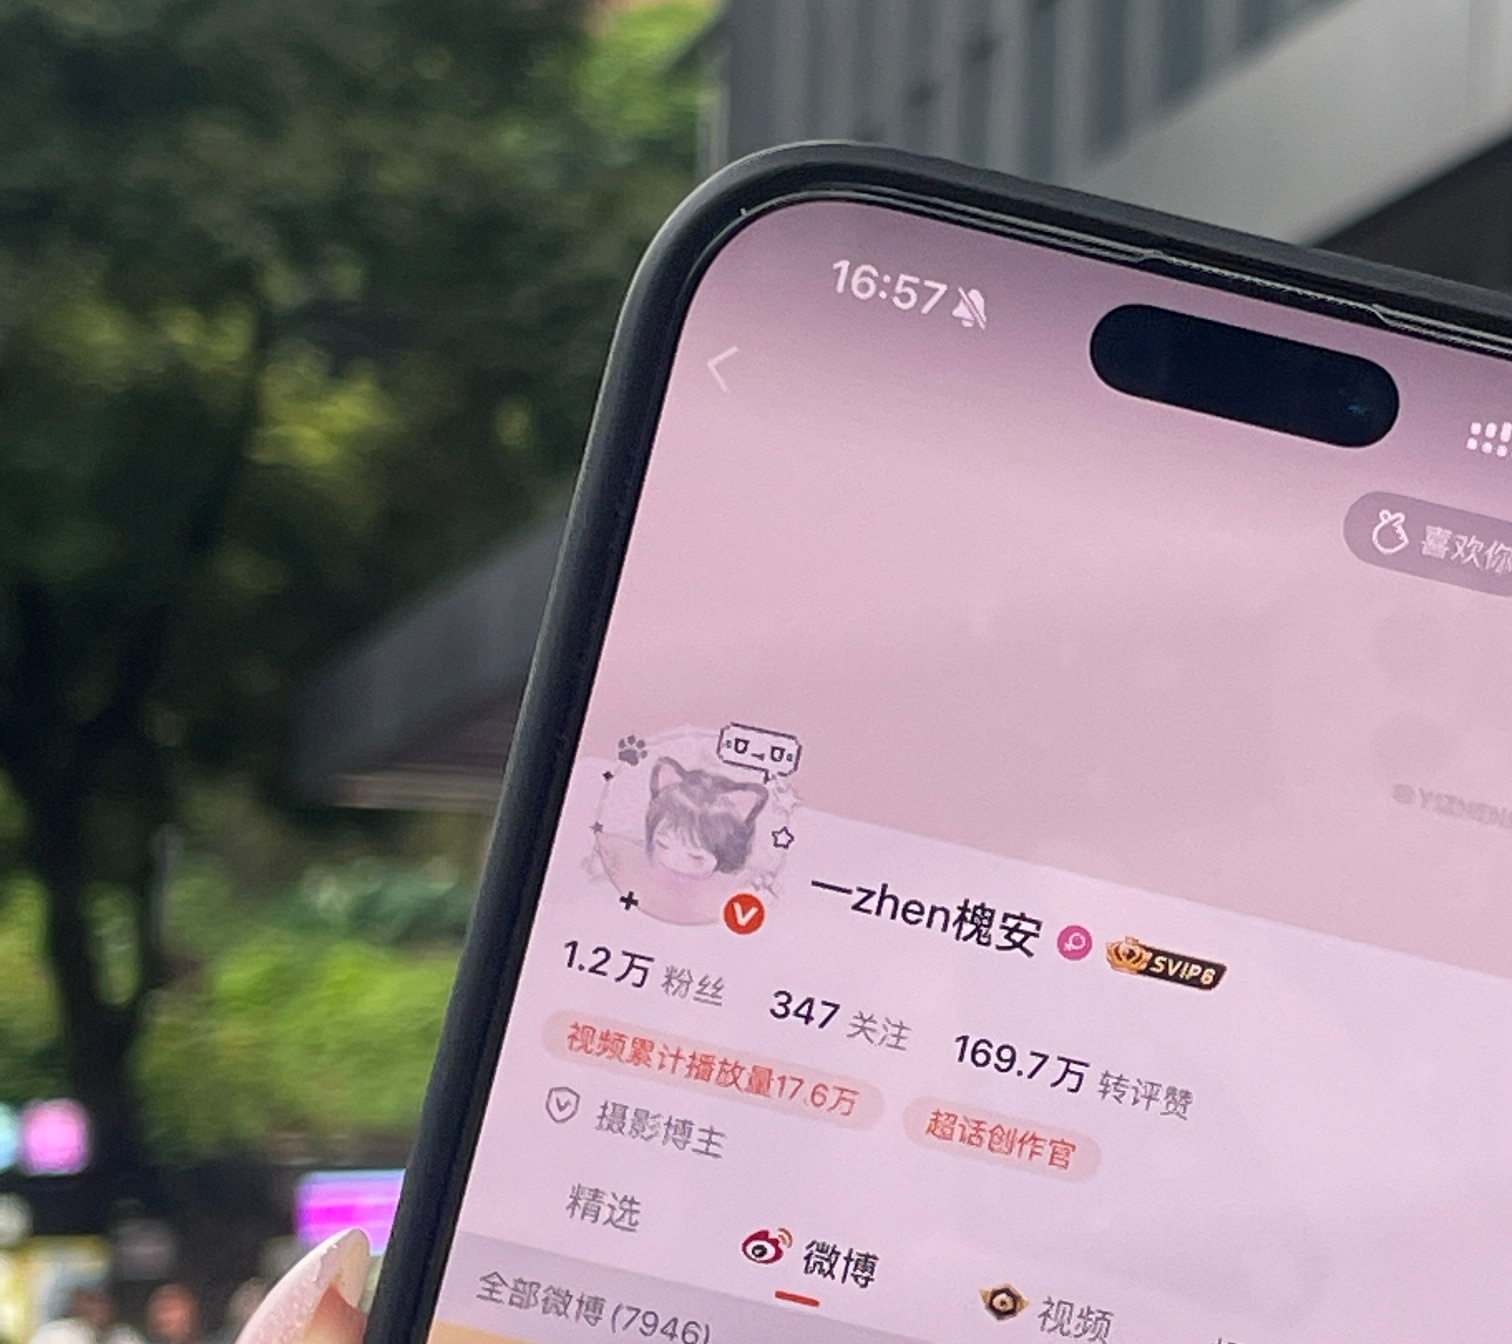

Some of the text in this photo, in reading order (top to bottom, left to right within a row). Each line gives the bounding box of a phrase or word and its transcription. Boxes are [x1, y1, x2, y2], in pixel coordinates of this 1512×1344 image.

[831, 259, 948, 316] 16:57
[1149, 955, 1217, 987] SVIP6
[564, 940, 1194, 1121] 1.2万 粉丝 347 关注 169.7万 转评赞
[567, 1021, 860, 1117] 视频累计播放量17.6万
[595, 1100, 727, 1160] 摄影博主
[925, 1108, 1077, 1172] 超话创作官
[564, 1183, 642, 1233] 精选
[802, 1239, 880, 1289] 微博
